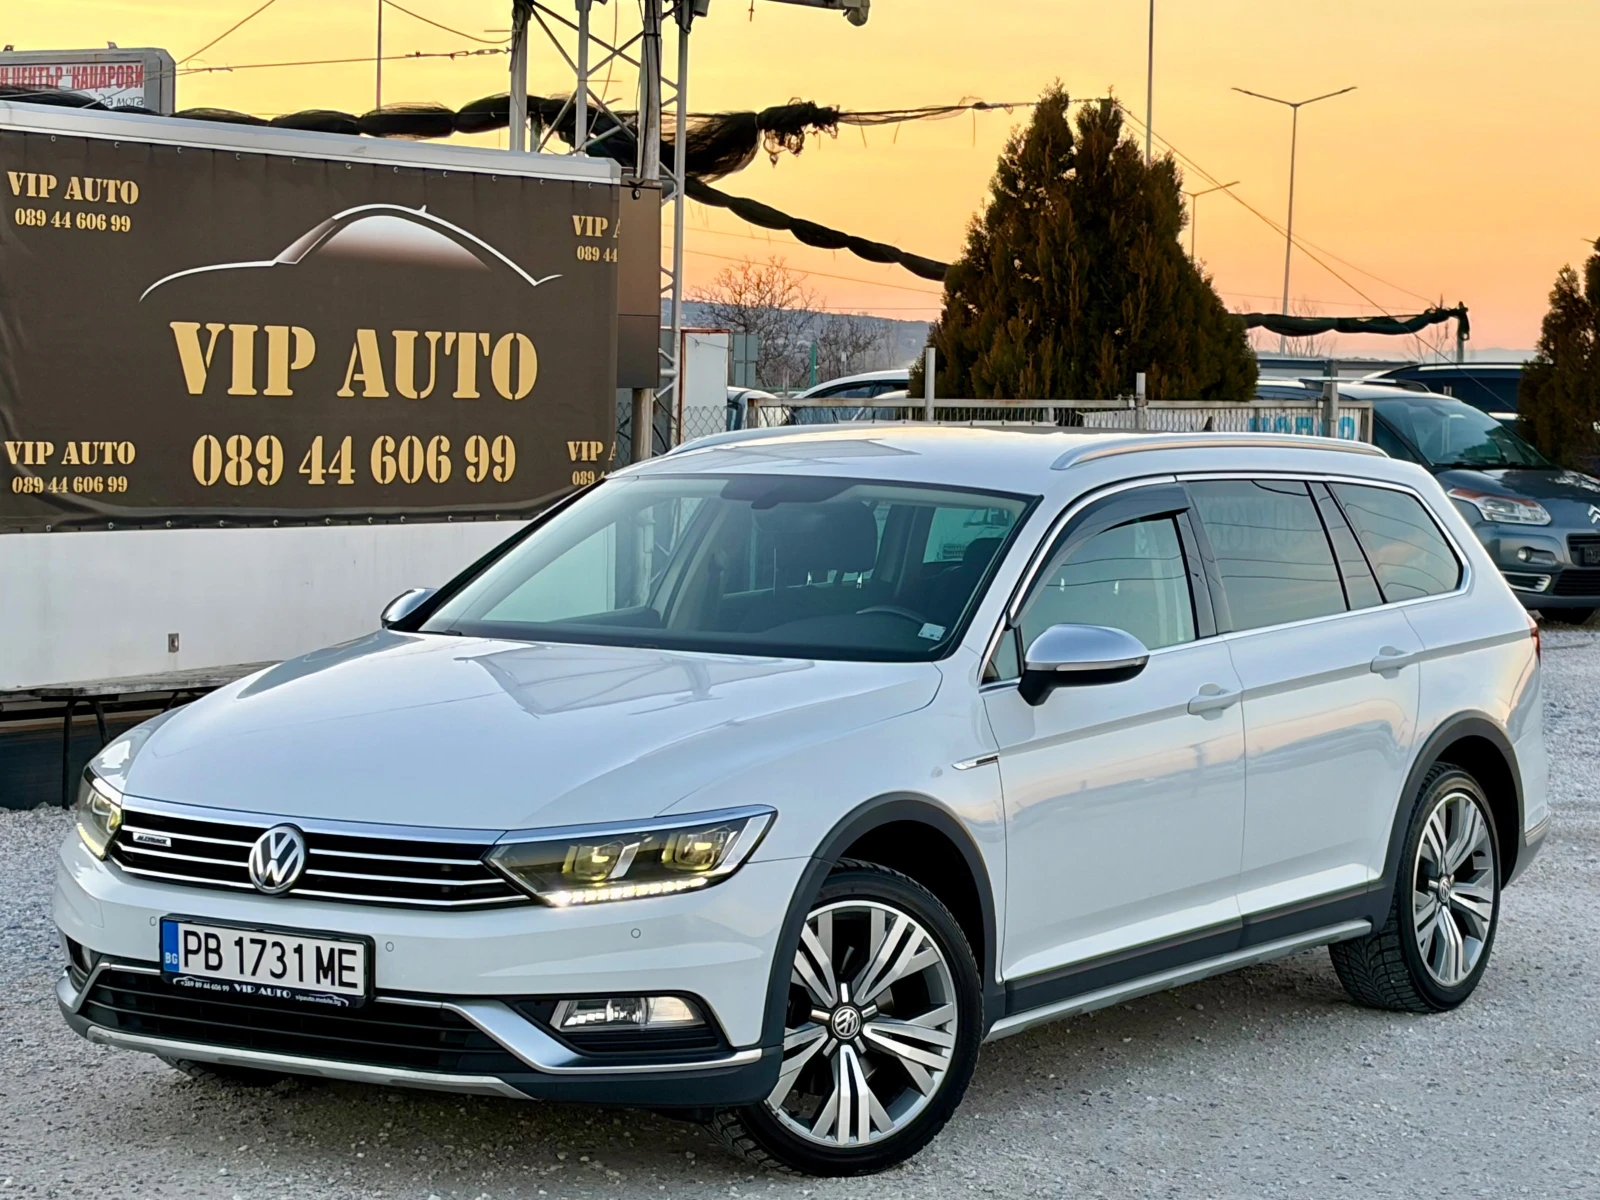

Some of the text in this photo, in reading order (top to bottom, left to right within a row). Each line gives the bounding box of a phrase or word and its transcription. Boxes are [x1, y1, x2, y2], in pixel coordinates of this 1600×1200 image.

[7, 171, 139, 205] VIP AUTO
[15, 208, 131, 232] 089 44 606 99
[572, 215, 609, 237] VIP
[576, 245, 618, 263] 089 44
[169, 321, 538, 400] VIP AUTO
[4, 441, 136, 465] VIP AUTO
[192, 433, 517, 486] 089 44 606 99
[567, 441, 604, 461] VIP
[12, 475, 128, 494] 089 44 606 99
[164, 951, 178, 965] BG
[183, 930, 358, 989] PB 1731 ME
[233, 983, 256, 994] VIP
[257, 987, 292, 999] AUTO
